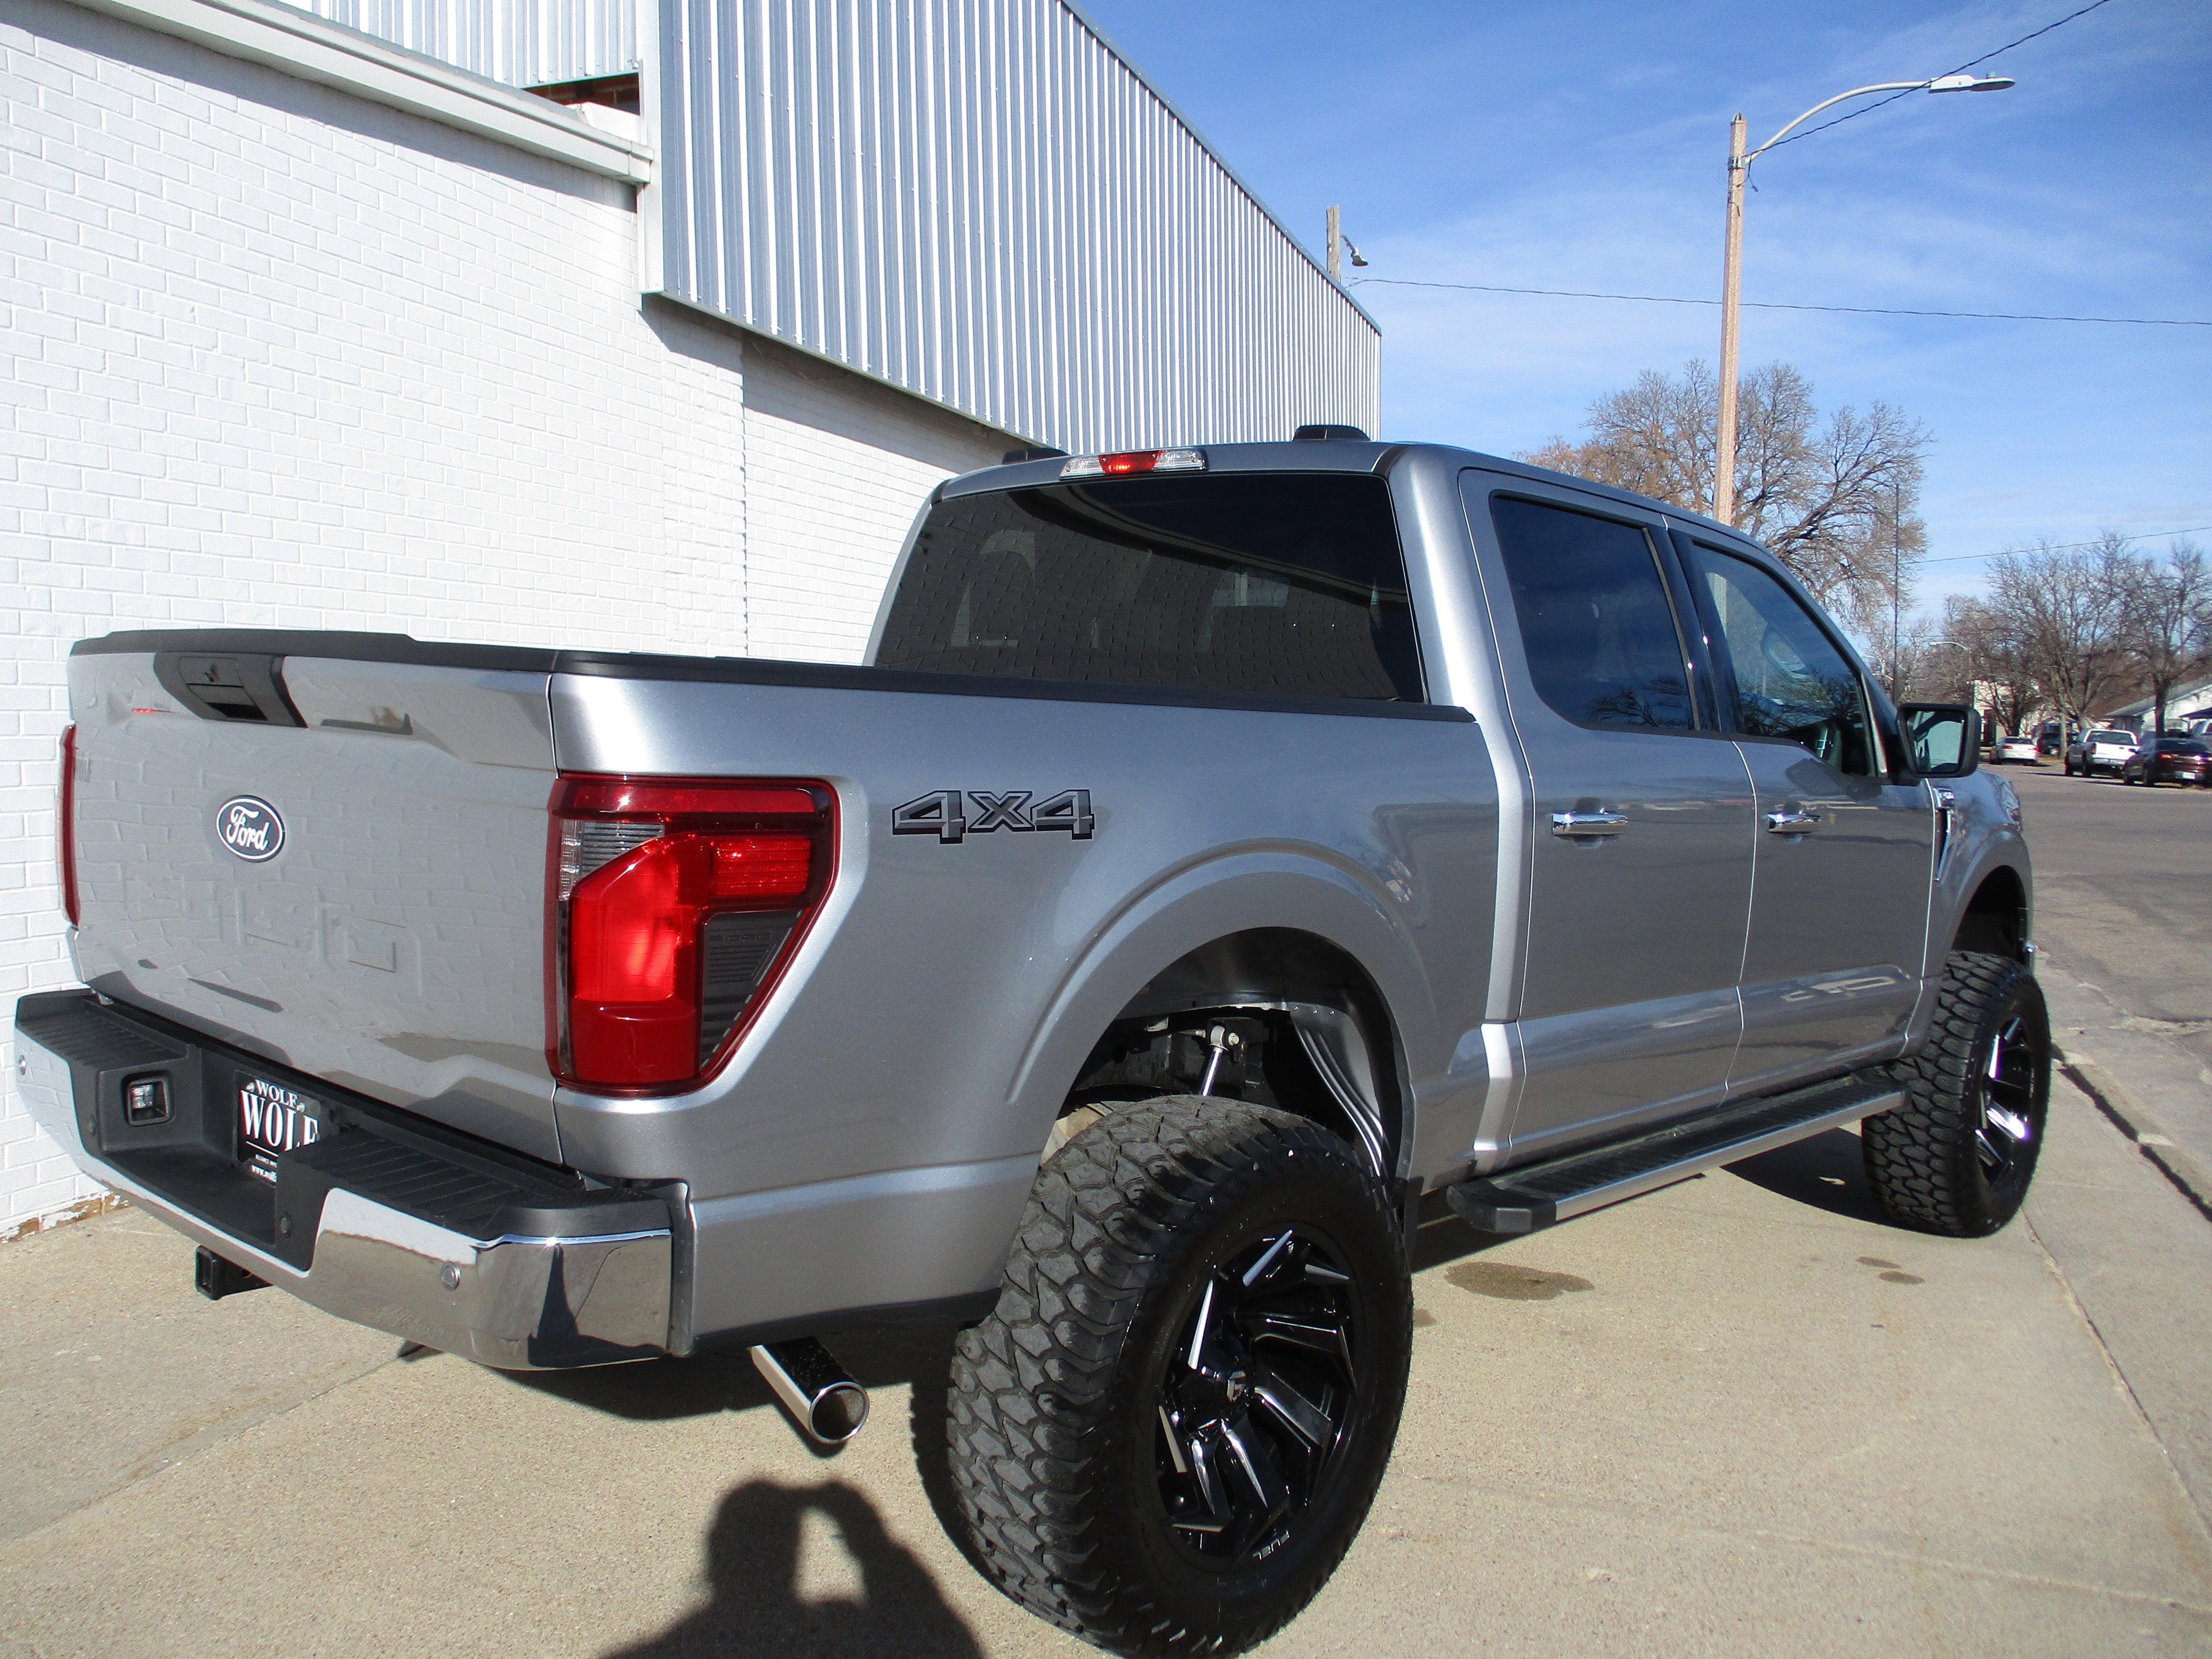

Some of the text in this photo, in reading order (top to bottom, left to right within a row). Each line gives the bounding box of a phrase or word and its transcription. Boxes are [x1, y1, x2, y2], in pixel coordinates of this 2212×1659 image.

[226, 805, 270, 851] Ford
[255, 1078, 298, 1109] WOLF
[239, 1090, 319, 1152] WOLF
